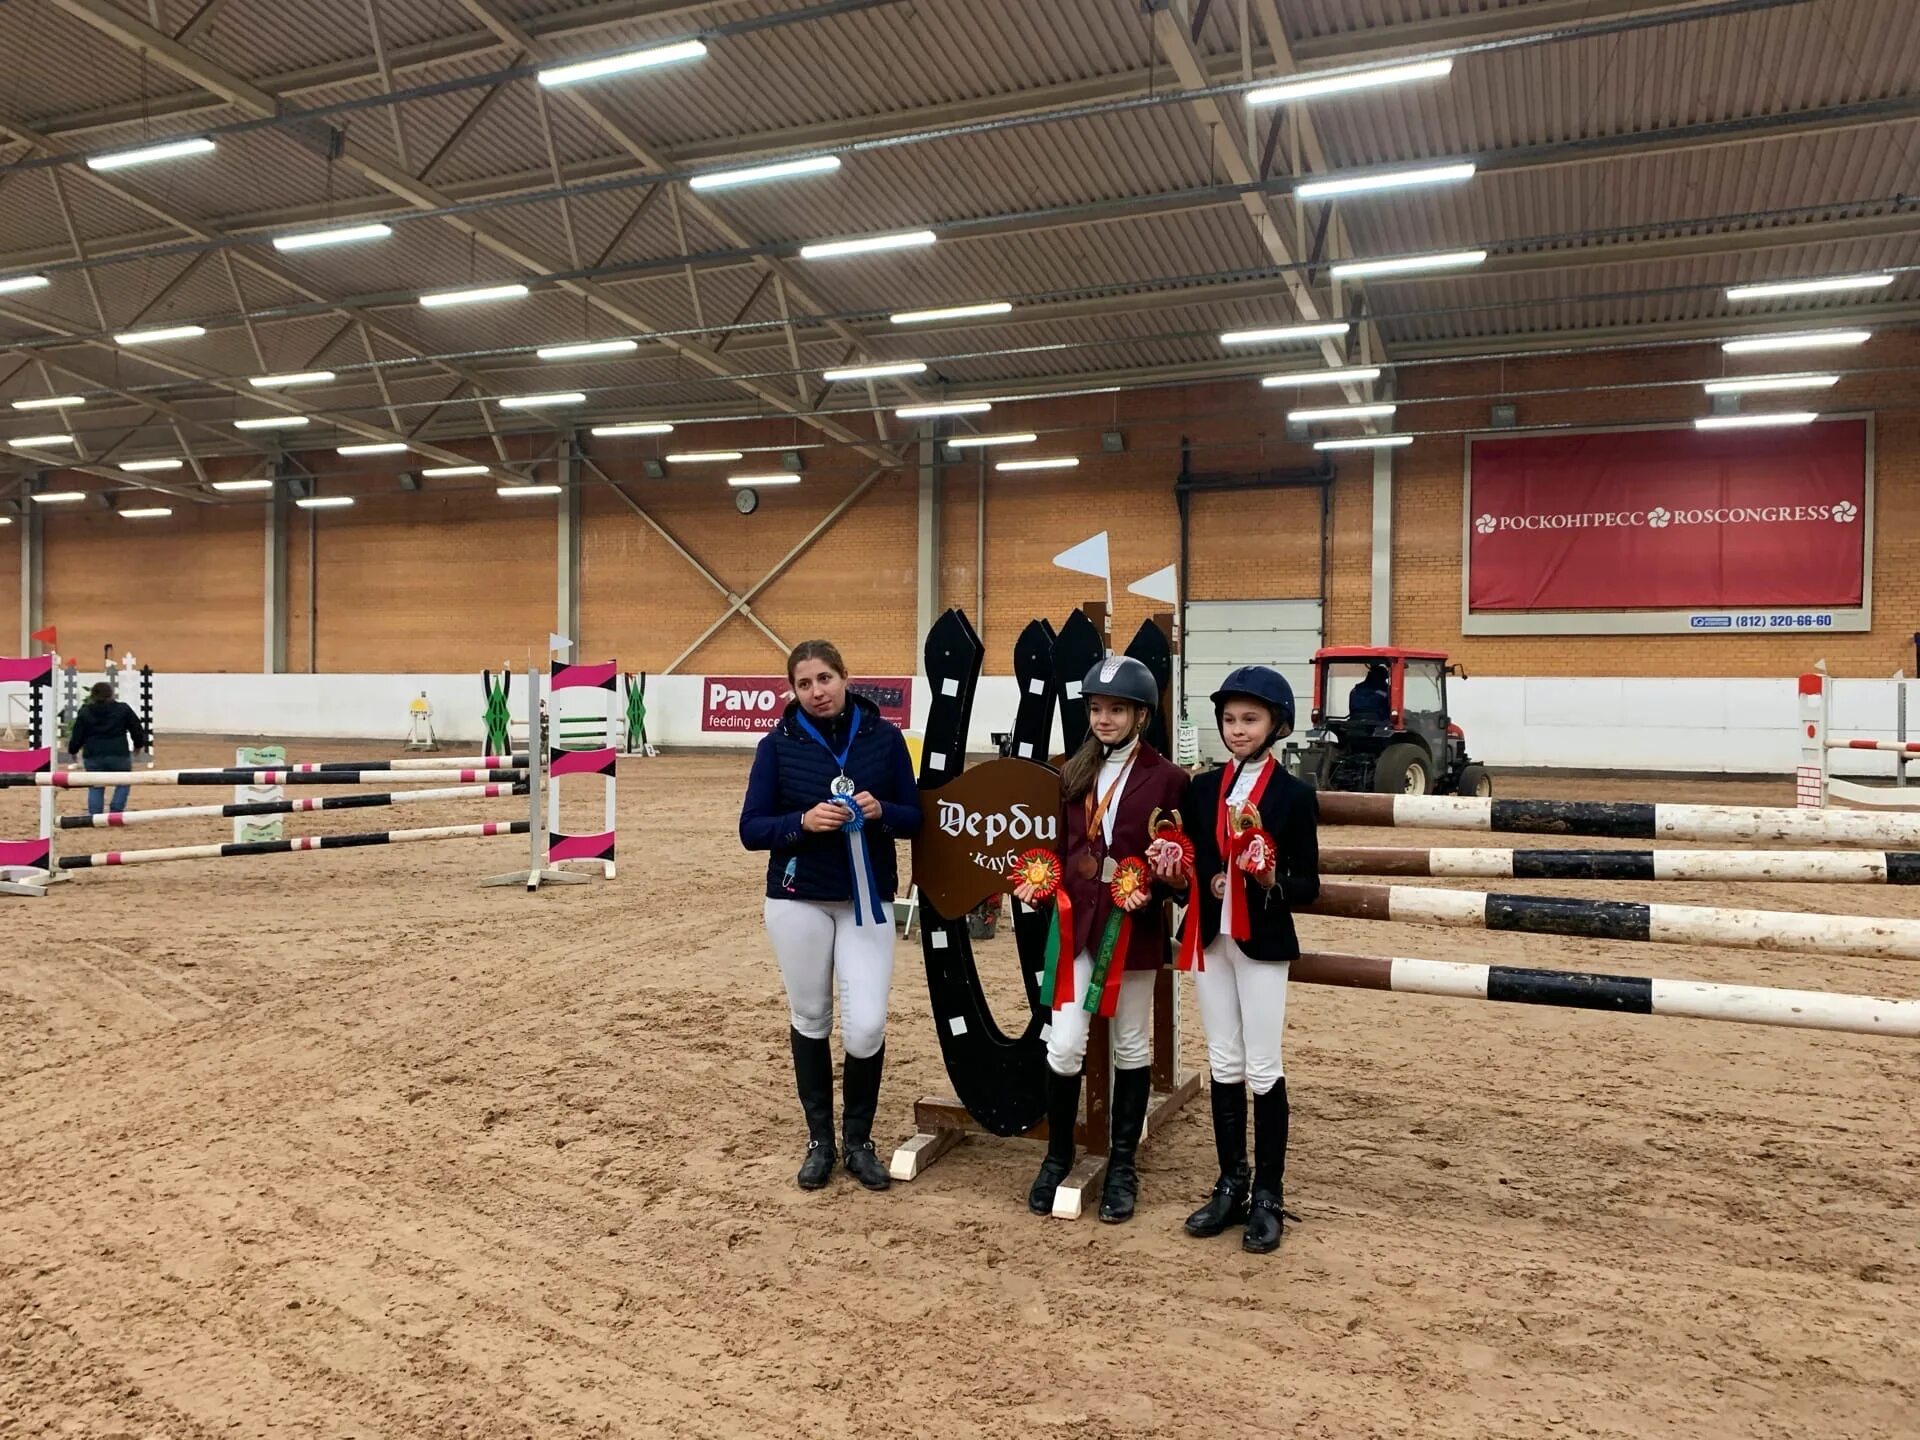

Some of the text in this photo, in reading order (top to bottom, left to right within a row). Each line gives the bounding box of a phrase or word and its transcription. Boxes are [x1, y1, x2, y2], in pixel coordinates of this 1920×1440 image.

[1499, 511, 1645, 530] РОСКОНГРЕСС
[1673, 505, 1830, 524] ROSCONGRESS
[1736, 616, 1766, 628] (812)
[1770, 614, 1832, 627] 320-66-60
[709, 683, 776, 711] Pavo
[709, 715, 751, 730] feeding
[937, 798, 1057, 846] Дерби
